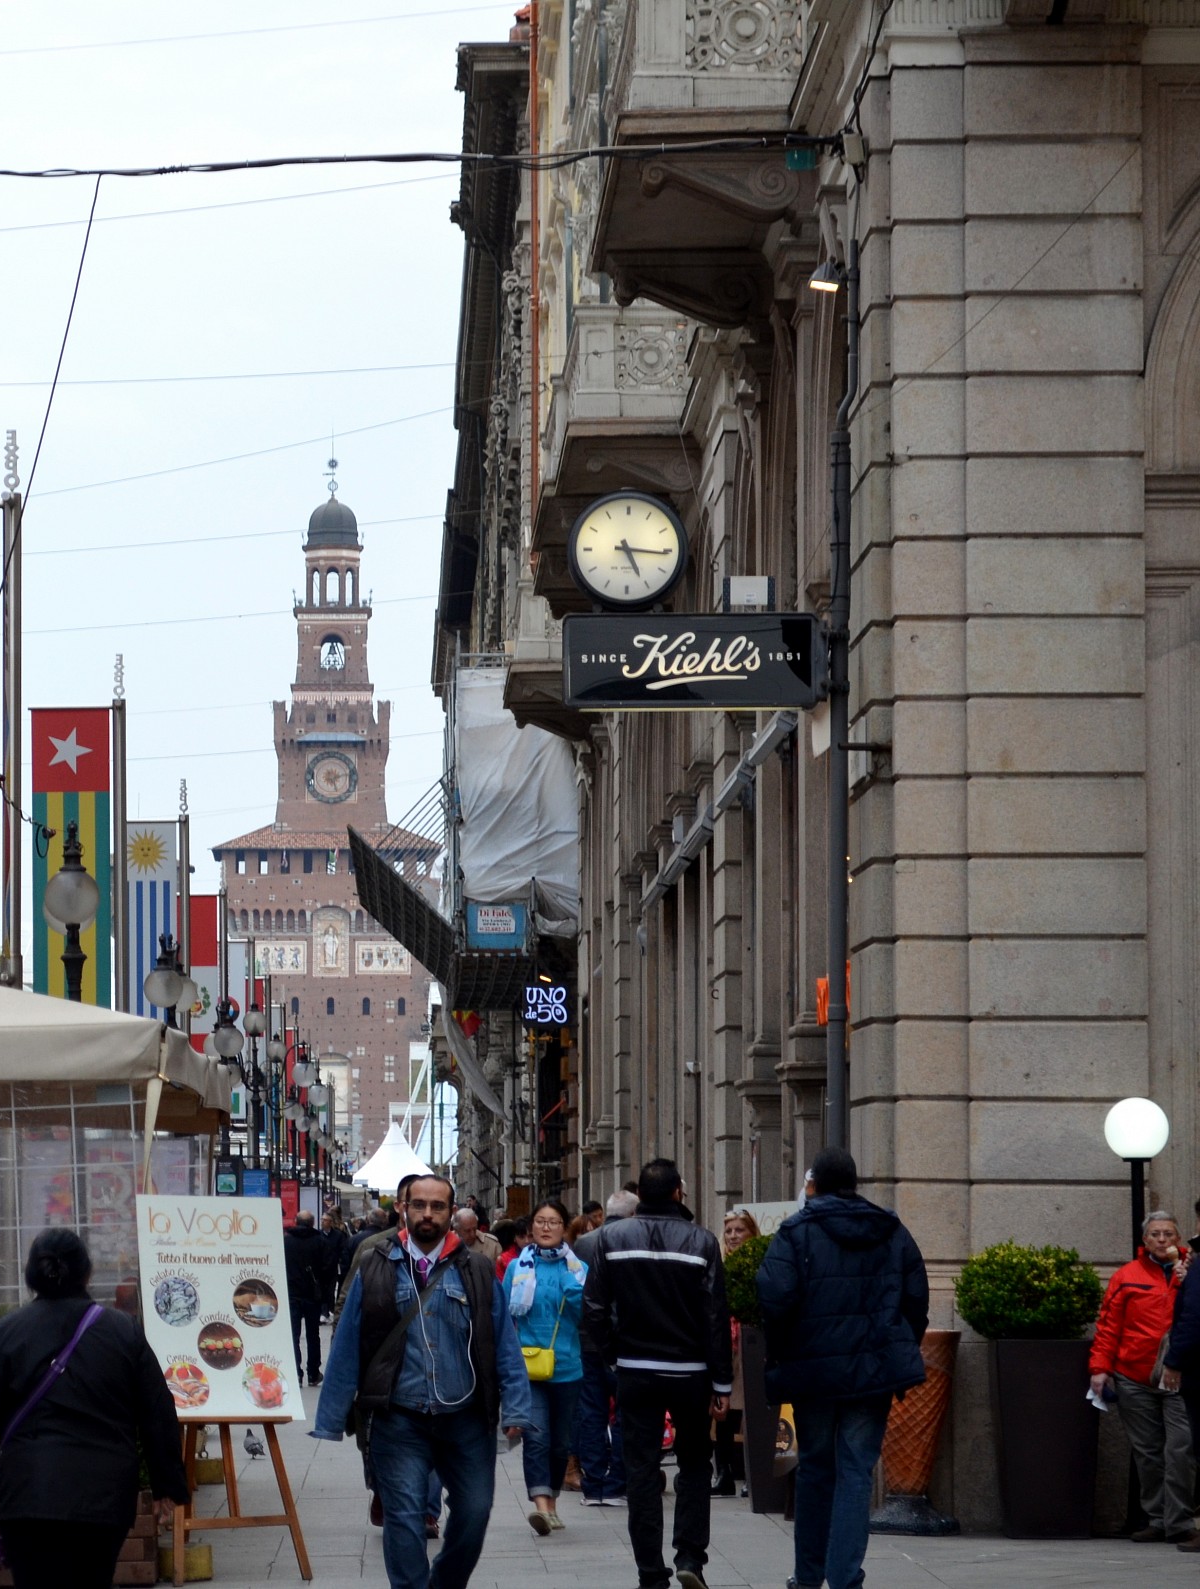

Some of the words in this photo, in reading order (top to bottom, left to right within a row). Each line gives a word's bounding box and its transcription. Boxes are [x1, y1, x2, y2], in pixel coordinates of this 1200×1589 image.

[581, 654, 627, 664] SINCE
[622, 632, 761, 679] Kiehl's
[768, 652, 802, 662] 1851
[526, 986, 566, 1004] UNO
[177, 1208, 258, 1241] Voglia
[156, 1252, 180, 1264] Tutto
[182, 1253, 188, 1264] il
[189, 1253, 216, 1264] buono
[149, 1268, 175, 1286] Gelato
[230, 1268, 276, 1286] Caffetteria
[198, 1310, 236, 1325] Fonduta
[166, 1354, 198, 1365] Crepes
[244, 1354, 282, 1368] Aperitivi
